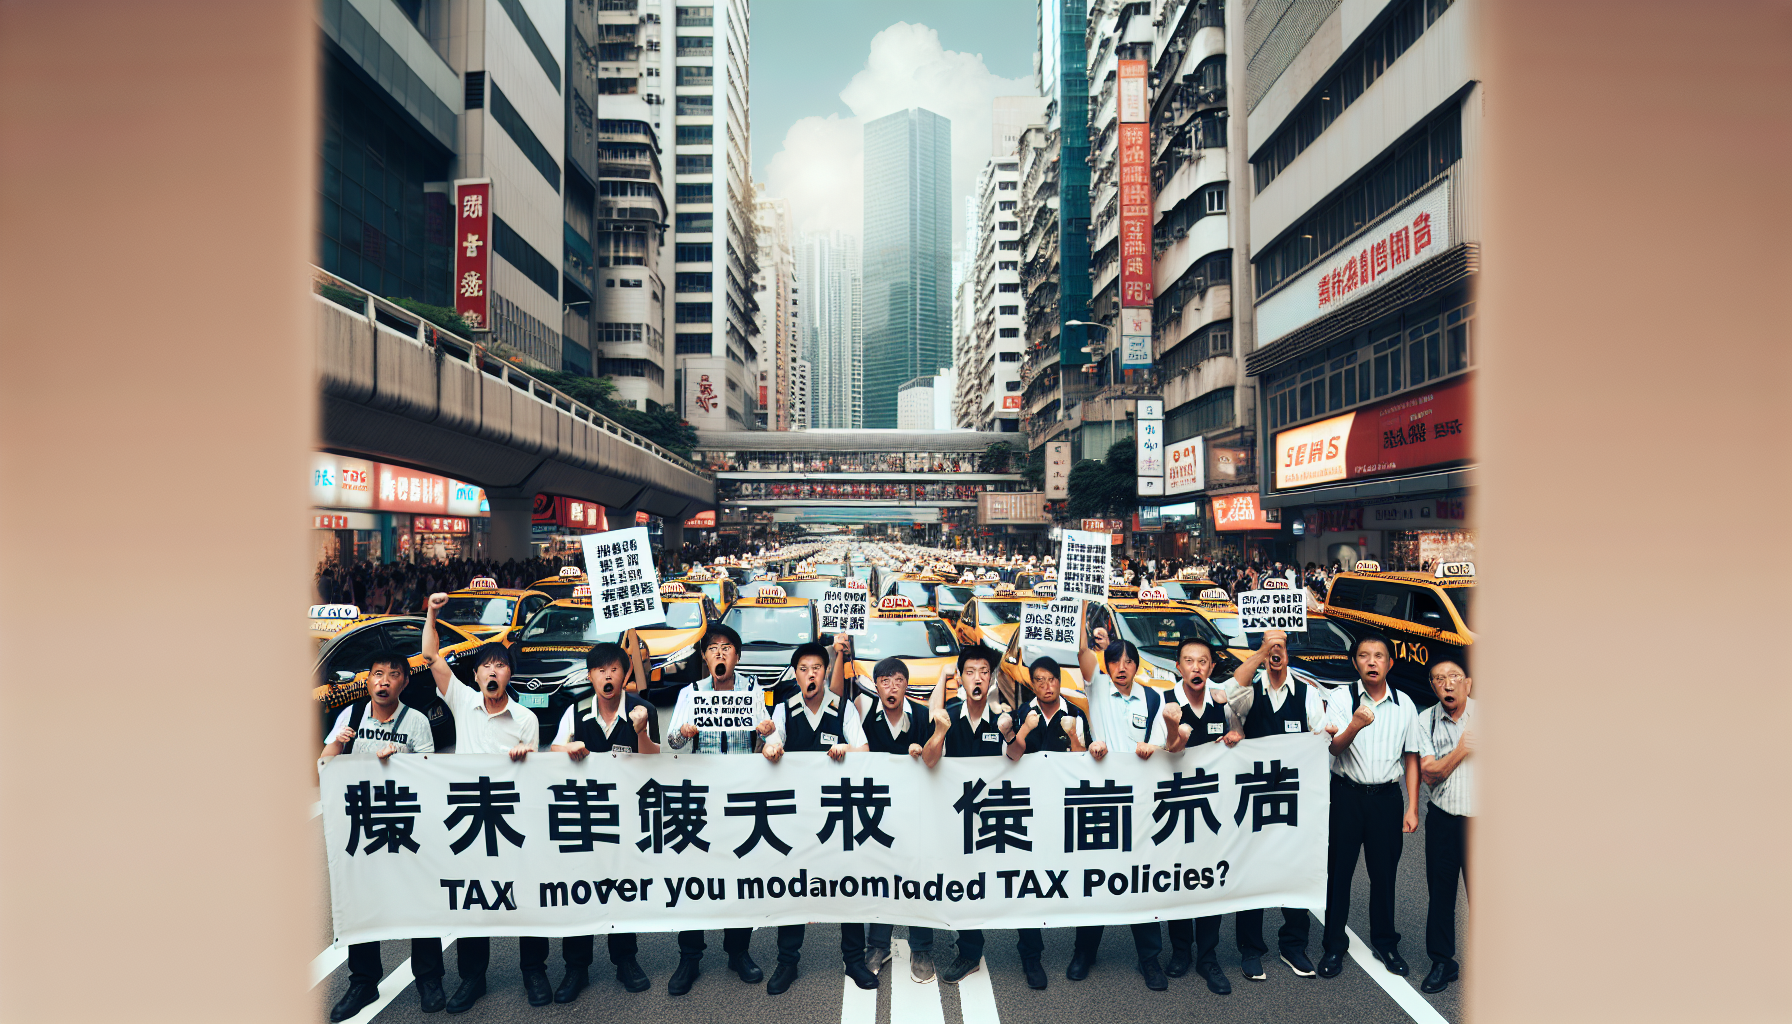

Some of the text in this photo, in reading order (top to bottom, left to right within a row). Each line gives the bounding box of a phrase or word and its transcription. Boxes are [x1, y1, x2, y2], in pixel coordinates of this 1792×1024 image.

[440, 878, 516, 911] TAX
[664, 876, 725, 908] you
[997, 869, 1068, 899] TAX
[1084, 860, 1230, 896] Policies?
